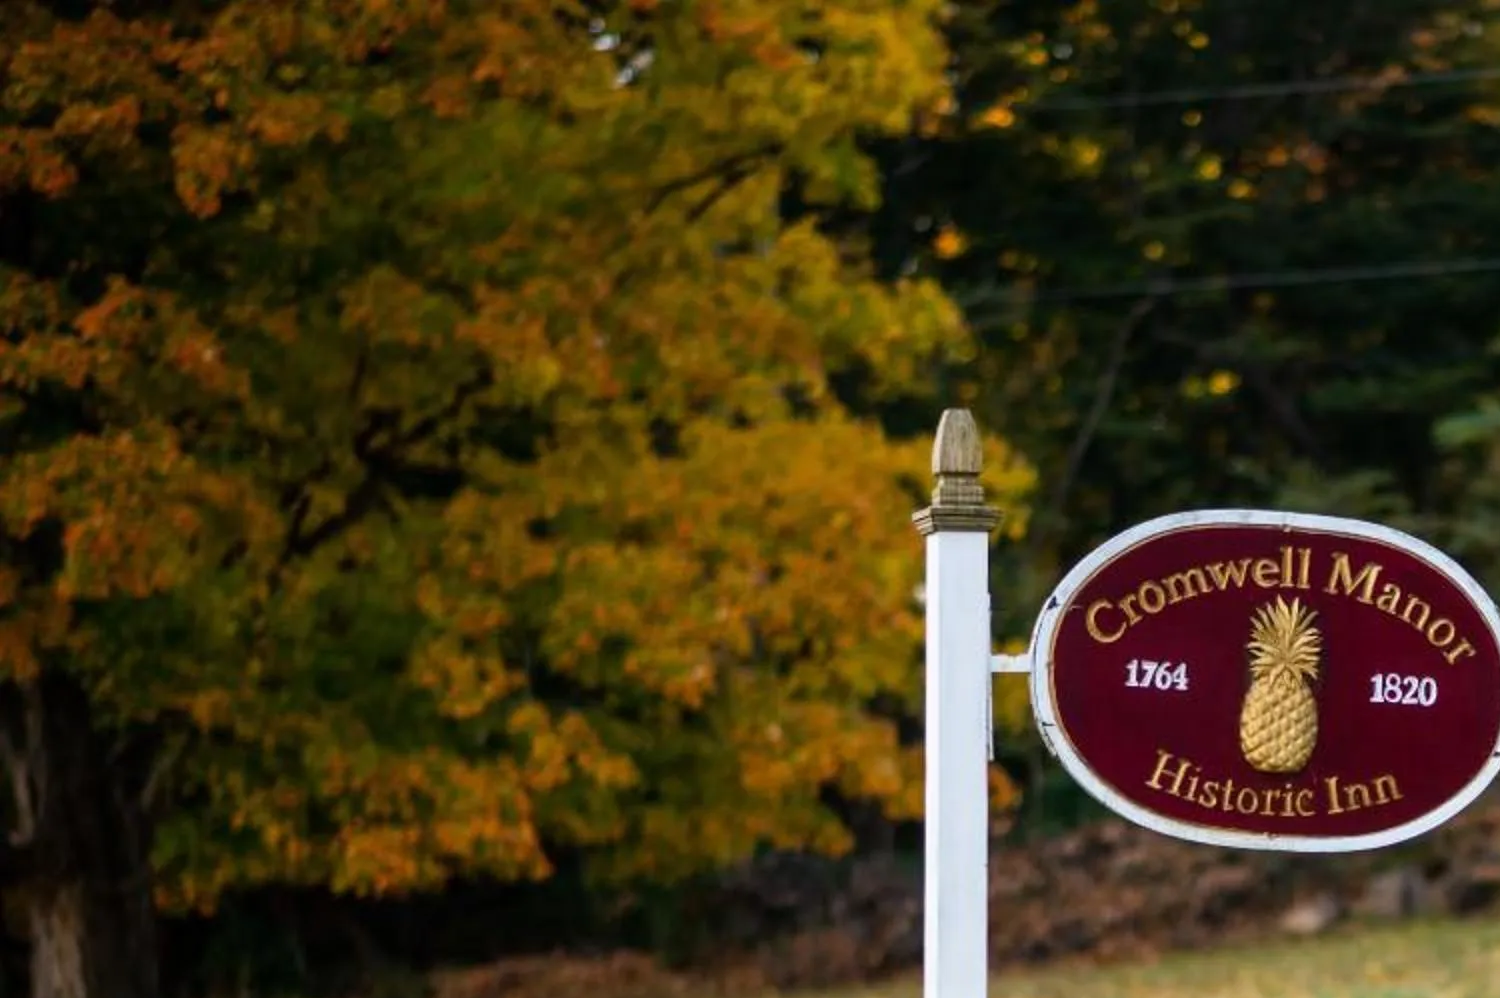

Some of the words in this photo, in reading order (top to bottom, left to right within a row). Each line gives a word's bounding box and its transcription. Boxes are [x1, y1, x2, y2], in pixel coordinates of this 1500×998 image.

[1085, 546, 1312, 645] Cromwell
[1325, 552, 1476, 666] Manor
[1124, 659, 1189, 691] 1764
[1369, 674, 1438, 706] 1820
[1145, 749, 1314, 817] Historic
[1326, 770, 1404, 815] Inn
